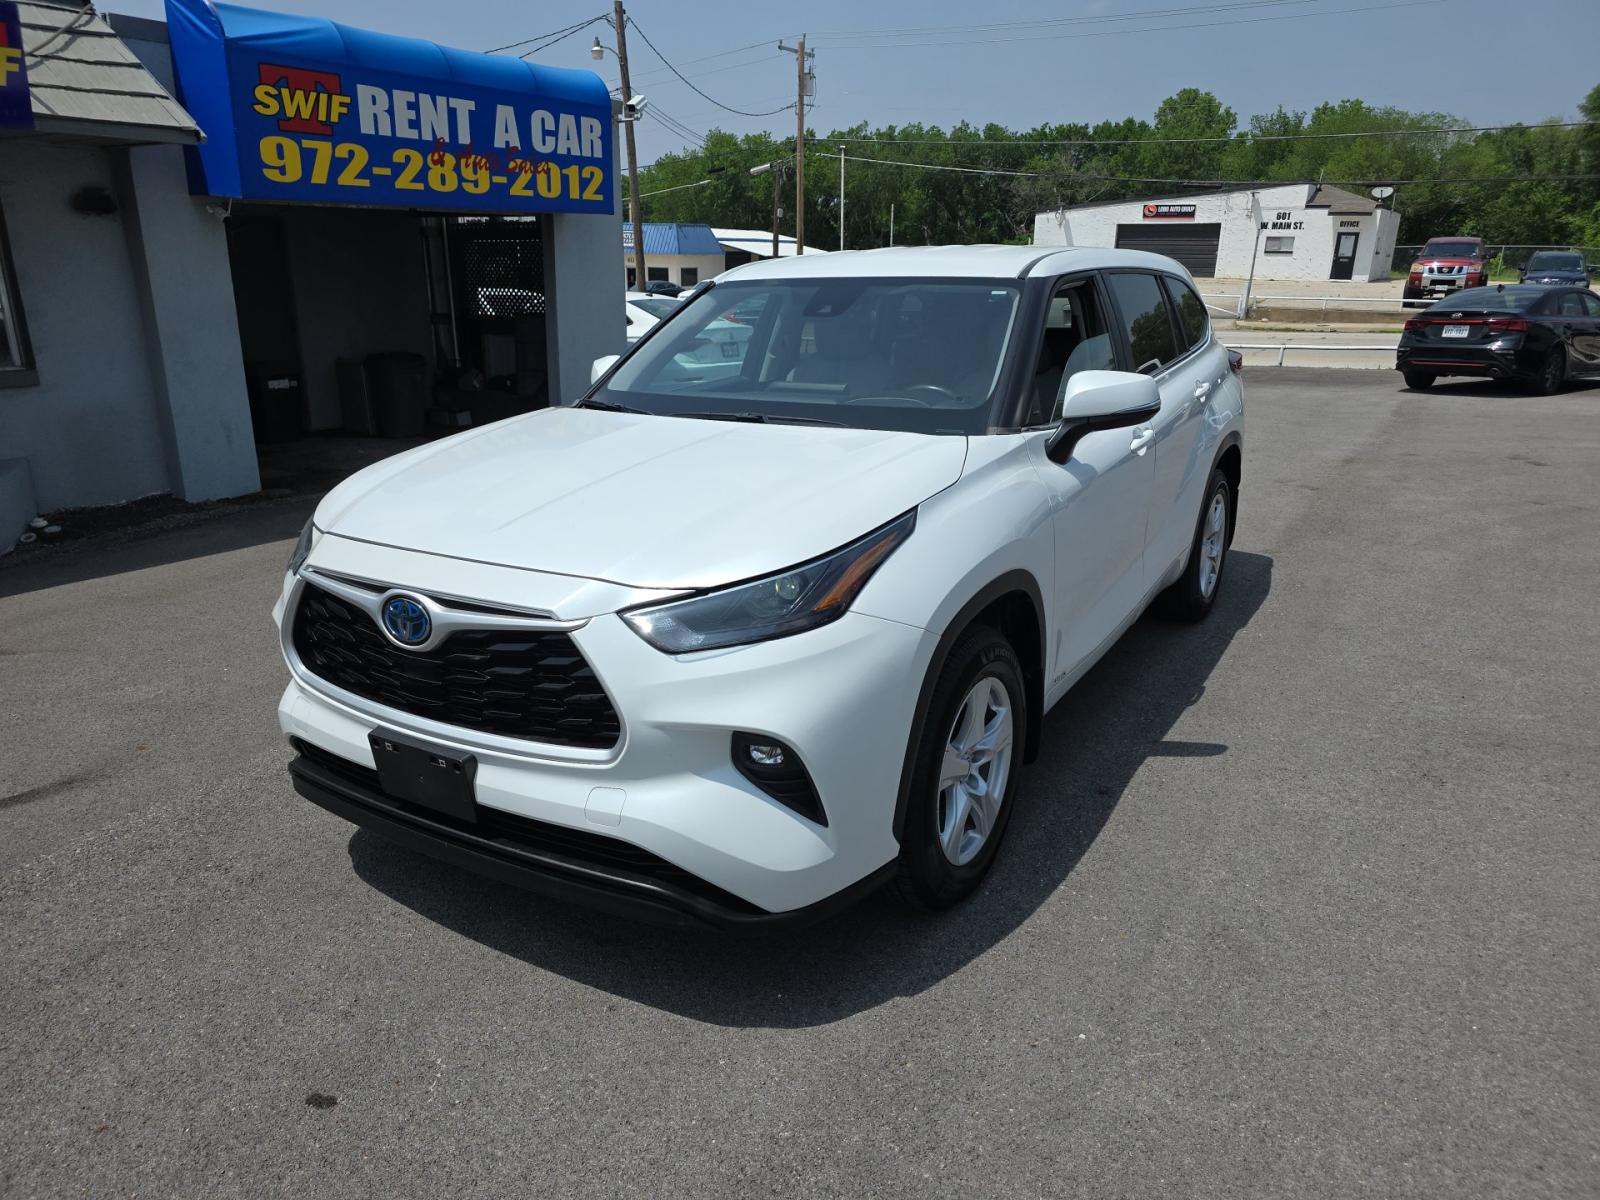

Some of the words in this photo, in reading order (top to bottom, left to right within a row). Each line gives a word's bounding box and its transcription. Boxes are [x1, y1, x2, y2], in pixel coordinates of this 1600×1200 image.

[356, 84, 476, 145] RENT
[494, 104, 521, 150] A
[531, 109, 603, 158] CAR
[259, 136, 604, 201] 972-289-2012
[1276, 211, 1291, 221] 601
[1271, 222, 1292, 230] MAIN
[1293, 221, 1305, 230] ST.
[1339, 220, 1360, 228] OFFICE
